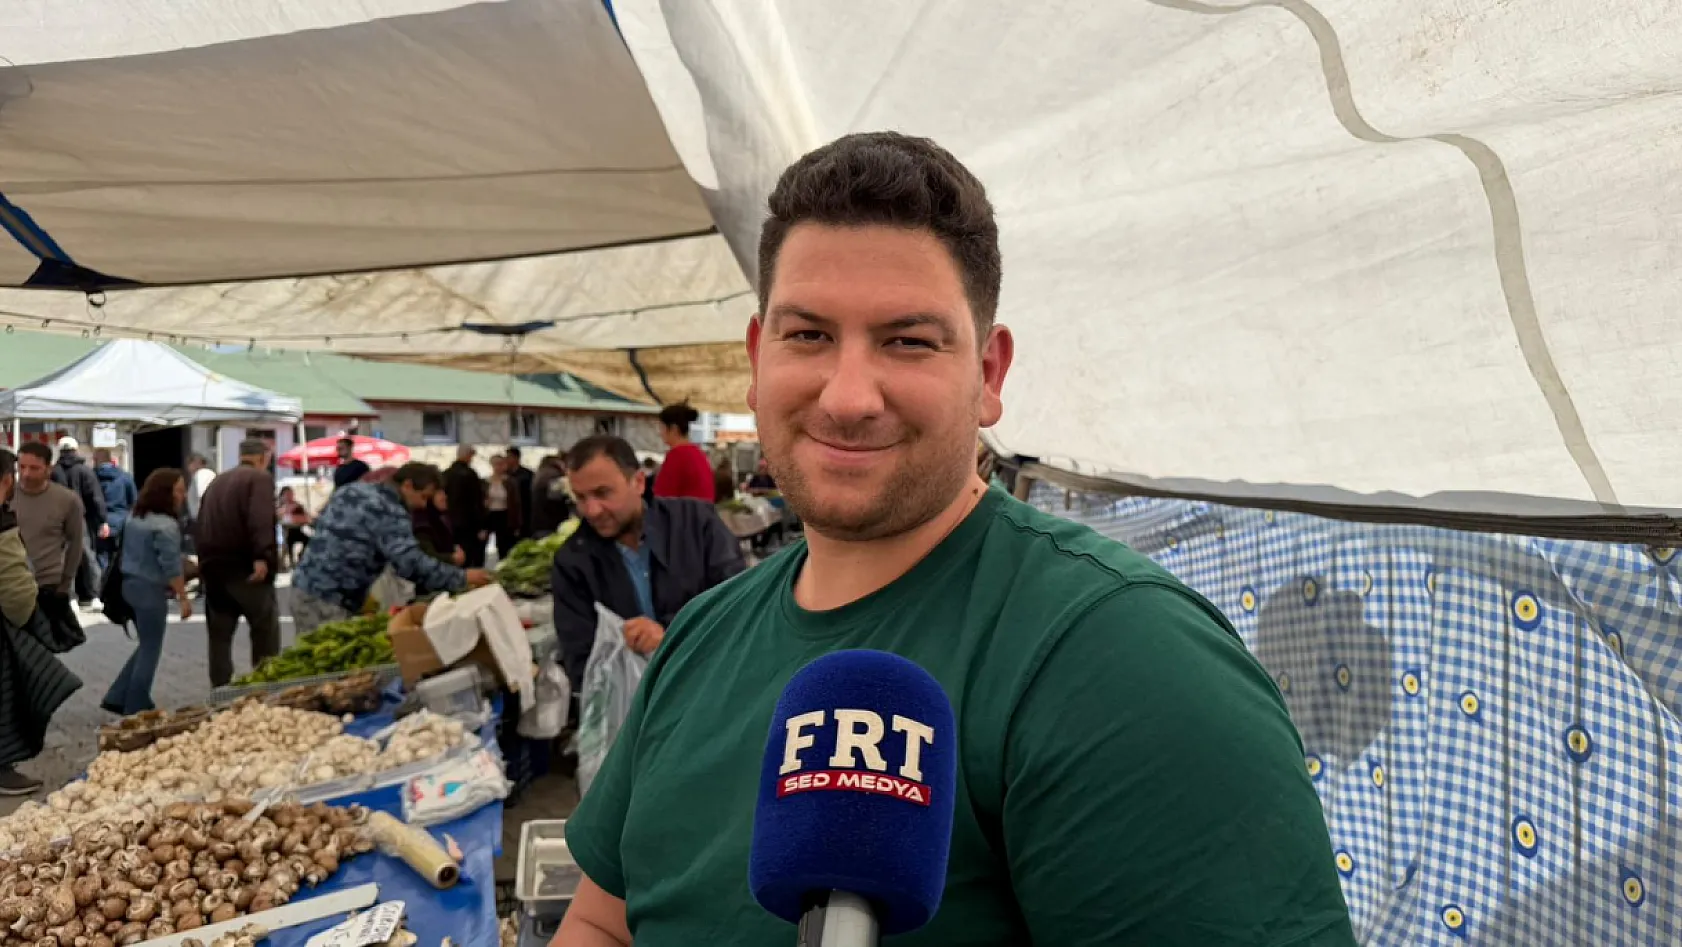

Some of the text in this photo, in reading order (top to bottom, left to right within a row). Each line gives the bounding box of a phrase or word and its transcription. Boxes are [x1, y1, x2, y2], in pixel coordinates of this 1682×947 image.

[779, 709, 935, 782] FRT
[784, 773, 924, 802] SED MEDYA
